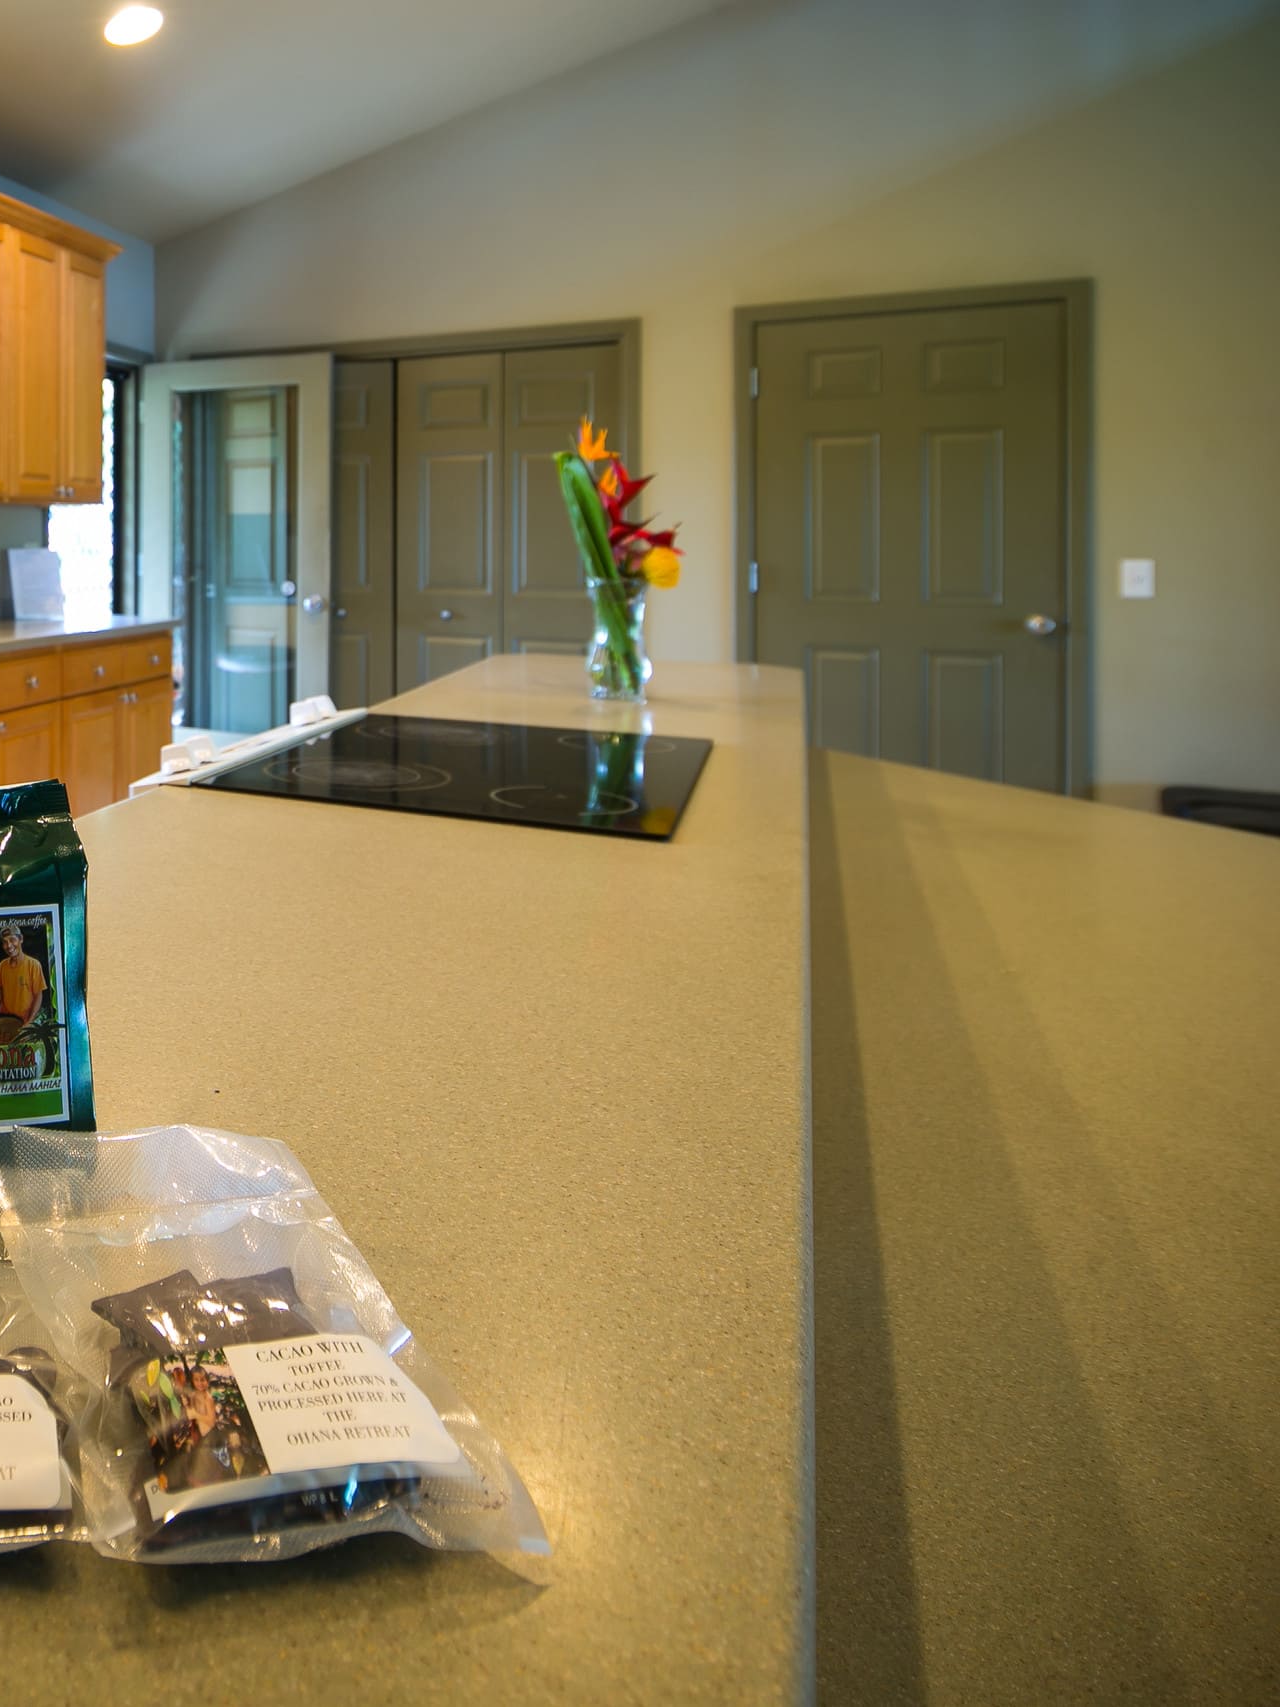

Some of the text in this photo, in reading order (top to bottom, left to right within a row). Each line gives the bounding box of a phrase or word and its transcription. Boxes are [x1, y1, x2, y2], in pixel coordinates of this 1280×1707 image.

[27, 914, 47, 929] coffee
[256, 1341, 365, 1363] CACAO WITH
[288, 1360, 345, 1376] TOFFEE
[252, 1384, 280, 1396] 70%
[282, 1378, 330, 1394] CACAO
[333, 1374, 386, 1387] GROWN
[258, 1391, 408, 1412] PROCESSED HERE AT
[323, 1409, 357, 1423] THE
[287, 1425, 411, 1446] OHANA RETREAT
